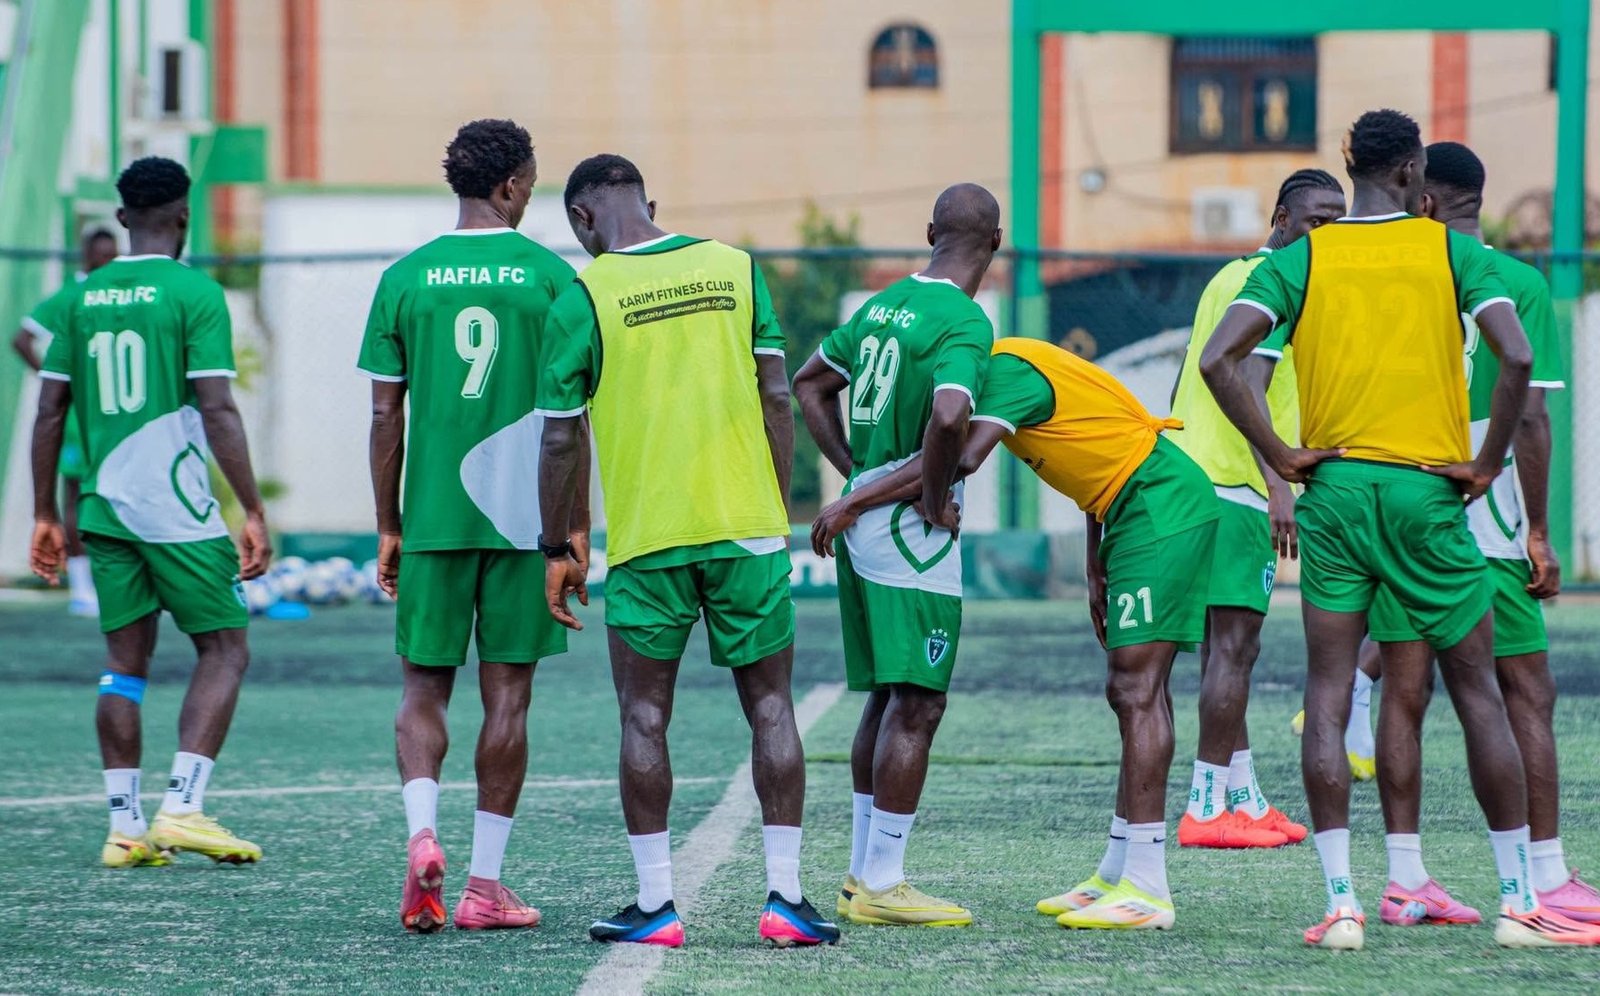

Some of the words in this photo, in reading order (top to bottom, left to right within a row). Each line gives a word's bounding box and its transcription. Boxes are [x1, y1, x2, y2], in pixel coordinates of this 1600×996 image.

[427, 267, 492, 286] HAFIA
[498, 266, 526, 284] FC
[133, 286, 157, 303] FC
[618, 291, 656, 309] KARIM
[656, 282, 704, 301] FITNESS
[706, 281, 735, 292] CLUB
[697, 301, 711, 311] par
[454, 306, 499, 399] 9
[87, 329, 147, 415] 10
[852, 335, 900, 425] 29
[1117, 586, 1153, 630] 21
